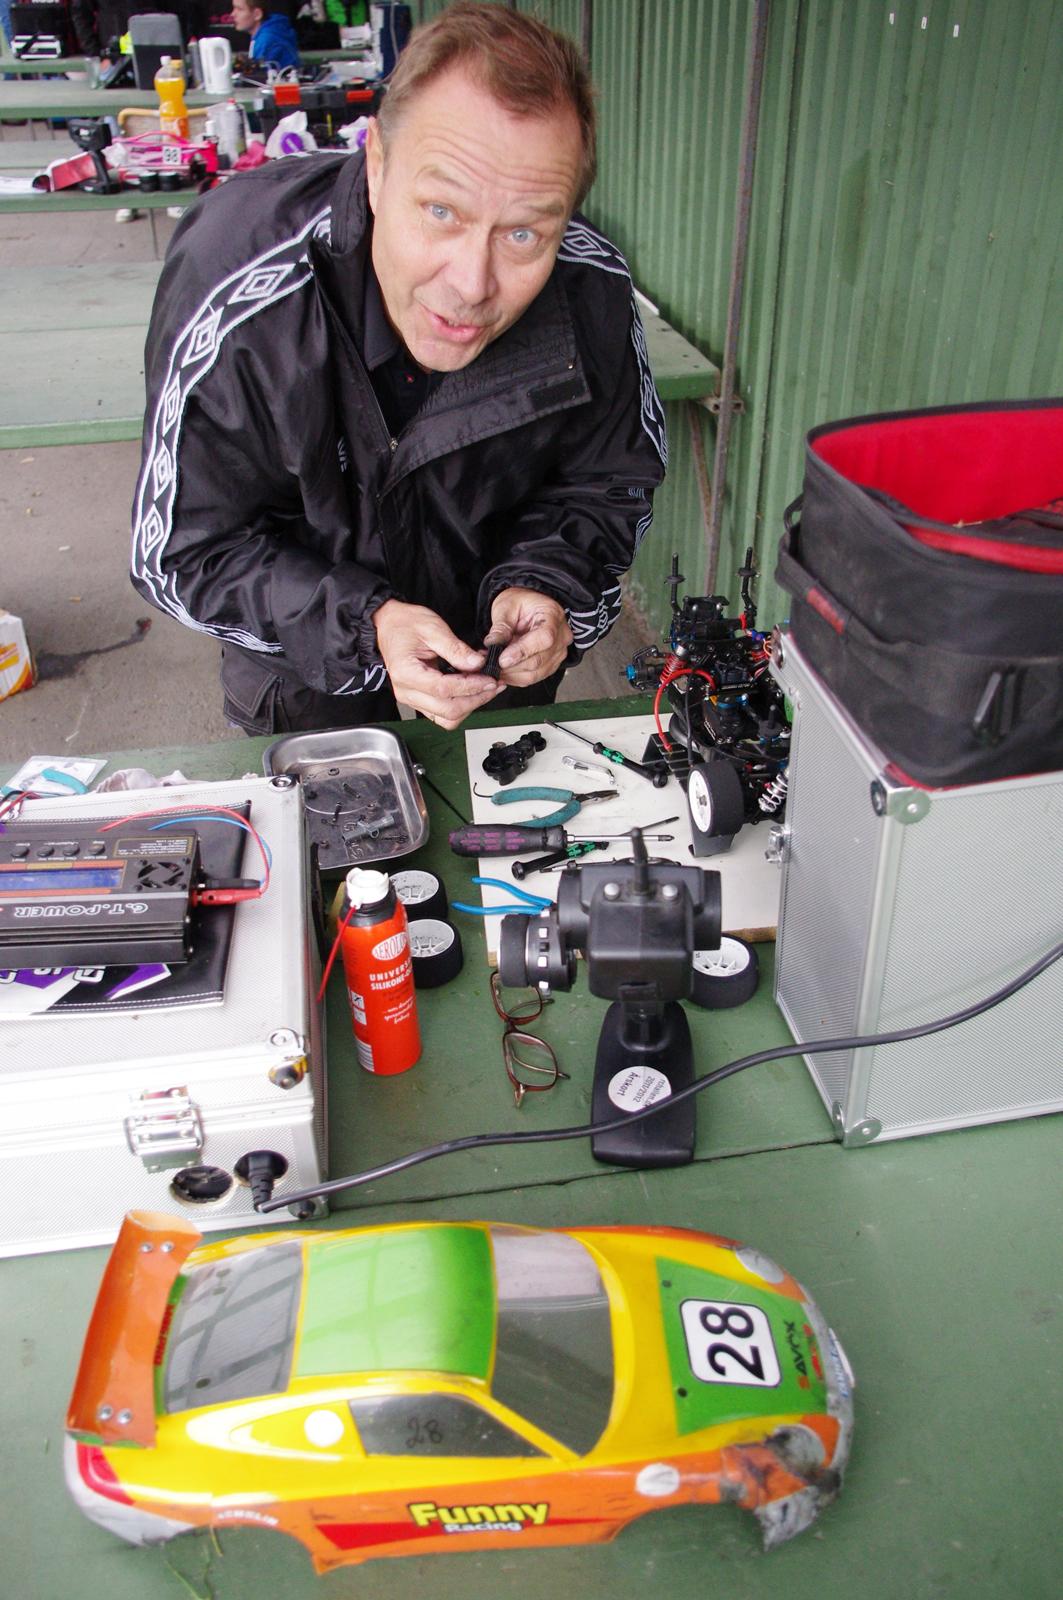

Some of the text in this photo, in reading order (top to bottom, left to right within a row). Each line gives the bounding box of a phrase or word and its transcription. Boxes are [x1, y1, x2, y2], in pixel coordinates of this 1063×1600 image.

[699, 1305, 766, 1382] 28
[405, 1417, 443, 1449] 28
[407, 1502, 549, 1528] Funny
[443, 1520, 524, 1533] Racing
